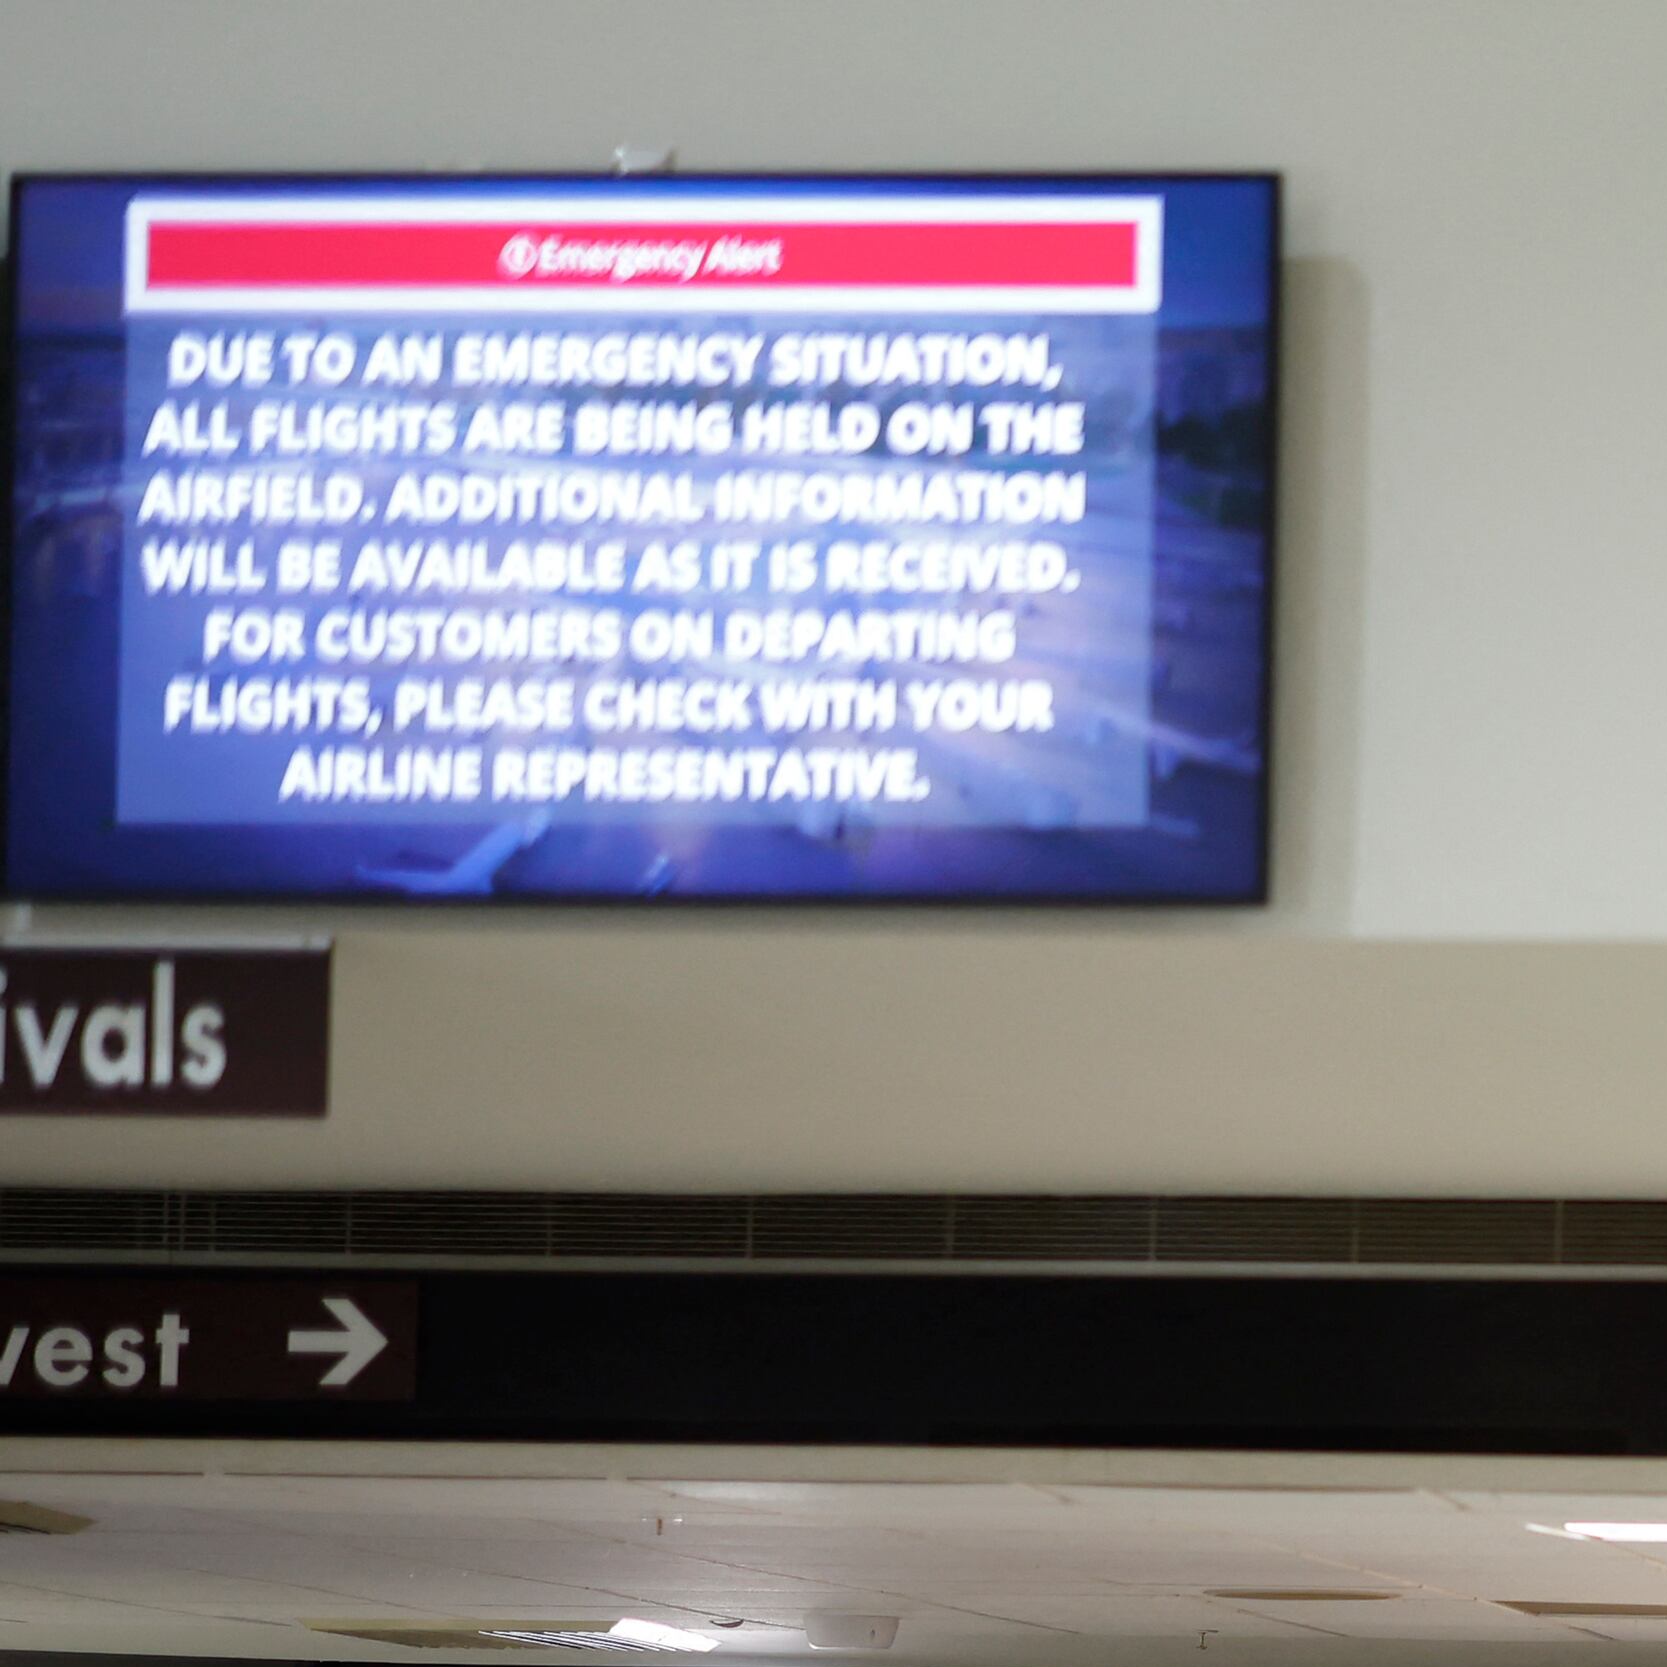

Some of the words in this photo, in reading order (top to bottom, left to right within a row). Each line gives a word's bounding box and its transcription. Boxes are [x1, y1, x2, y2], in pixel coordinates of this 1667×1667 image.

[538, 234, 705, 282] Emergency
[703, 233, 784, 276] Alert
[168, 333, 275, 387] DUE
[282, 333, 357, 387] TO
[361, 333, 445, 387] AN
[452, 333, 764, 387] EMERGENCY
[769, 333, 1064, 392] SITUATION,
[142, 403, 239, 456] ALL
[250, 403, 459, 456] FLIGHTS
[463, 403, 566, 456] ARE
[573, 403, 734, 456] BEING
[741, 403, 881, 456] HELD
[886, 403, 974, 456] ON
[979, 403, 1086, 456] THE
[137, 472, 376, 525] AIRFIELD.
[384, 472, 705, 525] ADDITIONAL
[712, 472, 1087, 525] INFORMATION
[140, 539, 267, 592] WILL
[277, 539, 342, 592] BE
[350, 539, 626, 592] AVAILABLE
[632, 539, 702, 592] AS
[709, 539, 762, 592] IT
[768, 539, 818, 592] IS
[825, 539, 1082, 592] RECEIVED.
[203, 610, 306, 664] FOR
[315, 610, 622, 664] CUSTOMERS
[629, 610, 715, 664] ON
[725, 610, 1017, 664] DEPARTING
[163, 678, 384, 738] FLIGHTS,
[394, 678, 574, 733] PLEASE
[584, 678, 756, 733] CHECK
[760, 678, 898, 733] WITH
[905, 678, 1054, 733] YOUR
[279, 749, 482, 801] AIRLINE
[492, 749, 932, 801] REPRESENTATIVE.
[0, 956, 227, 1090] vals
